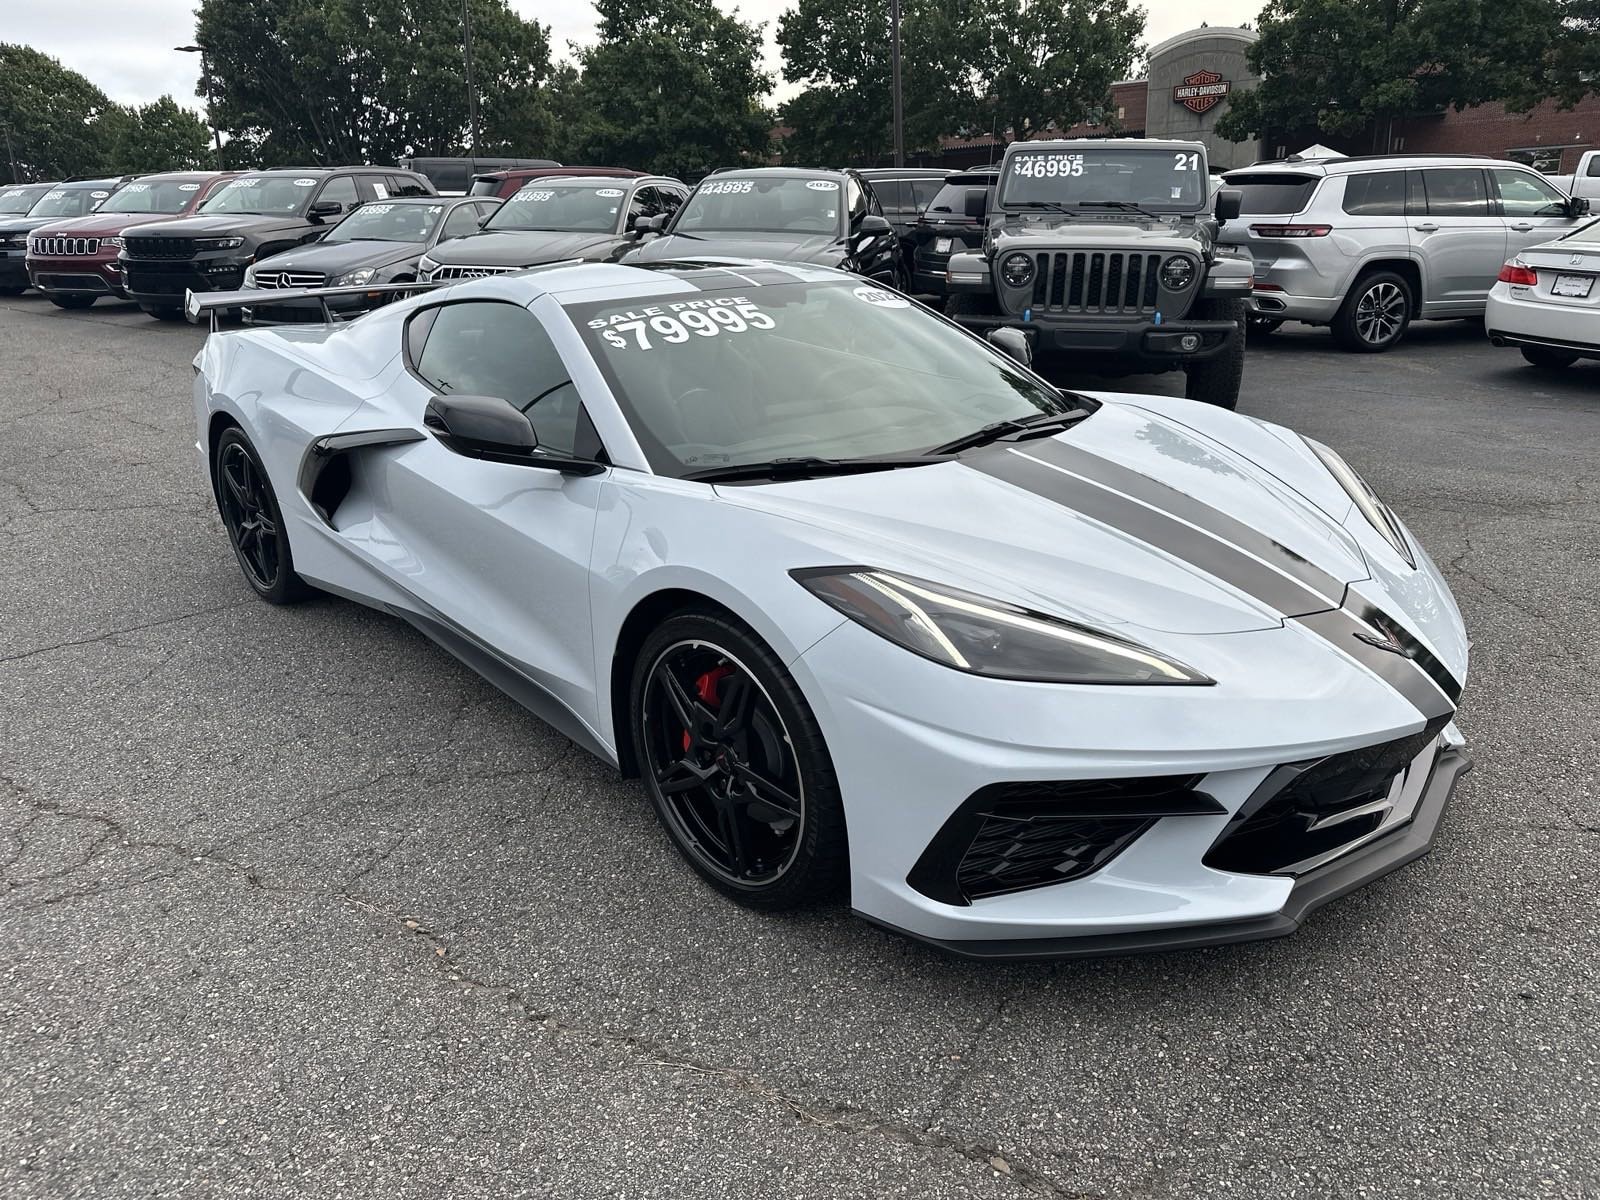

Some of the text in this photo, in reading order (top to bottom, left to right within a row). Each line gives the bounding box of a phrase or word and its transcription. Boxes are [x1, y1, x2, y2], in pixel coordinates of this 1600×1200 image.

[1189, 75, 1216, 84] MOTOR
[1177, 84, 1226, 98] HARLEY-DAVIDSON
[1188, 97, 1214, 110] CYCLES
[1014, 159, 1084, 178] $46995
[1174, 153, 1199, 171] 21
[428, 205, 442, 214] 14
[587, 296, 752, 329] SALE PRICE
[602, 304, 776, 351] $79995
